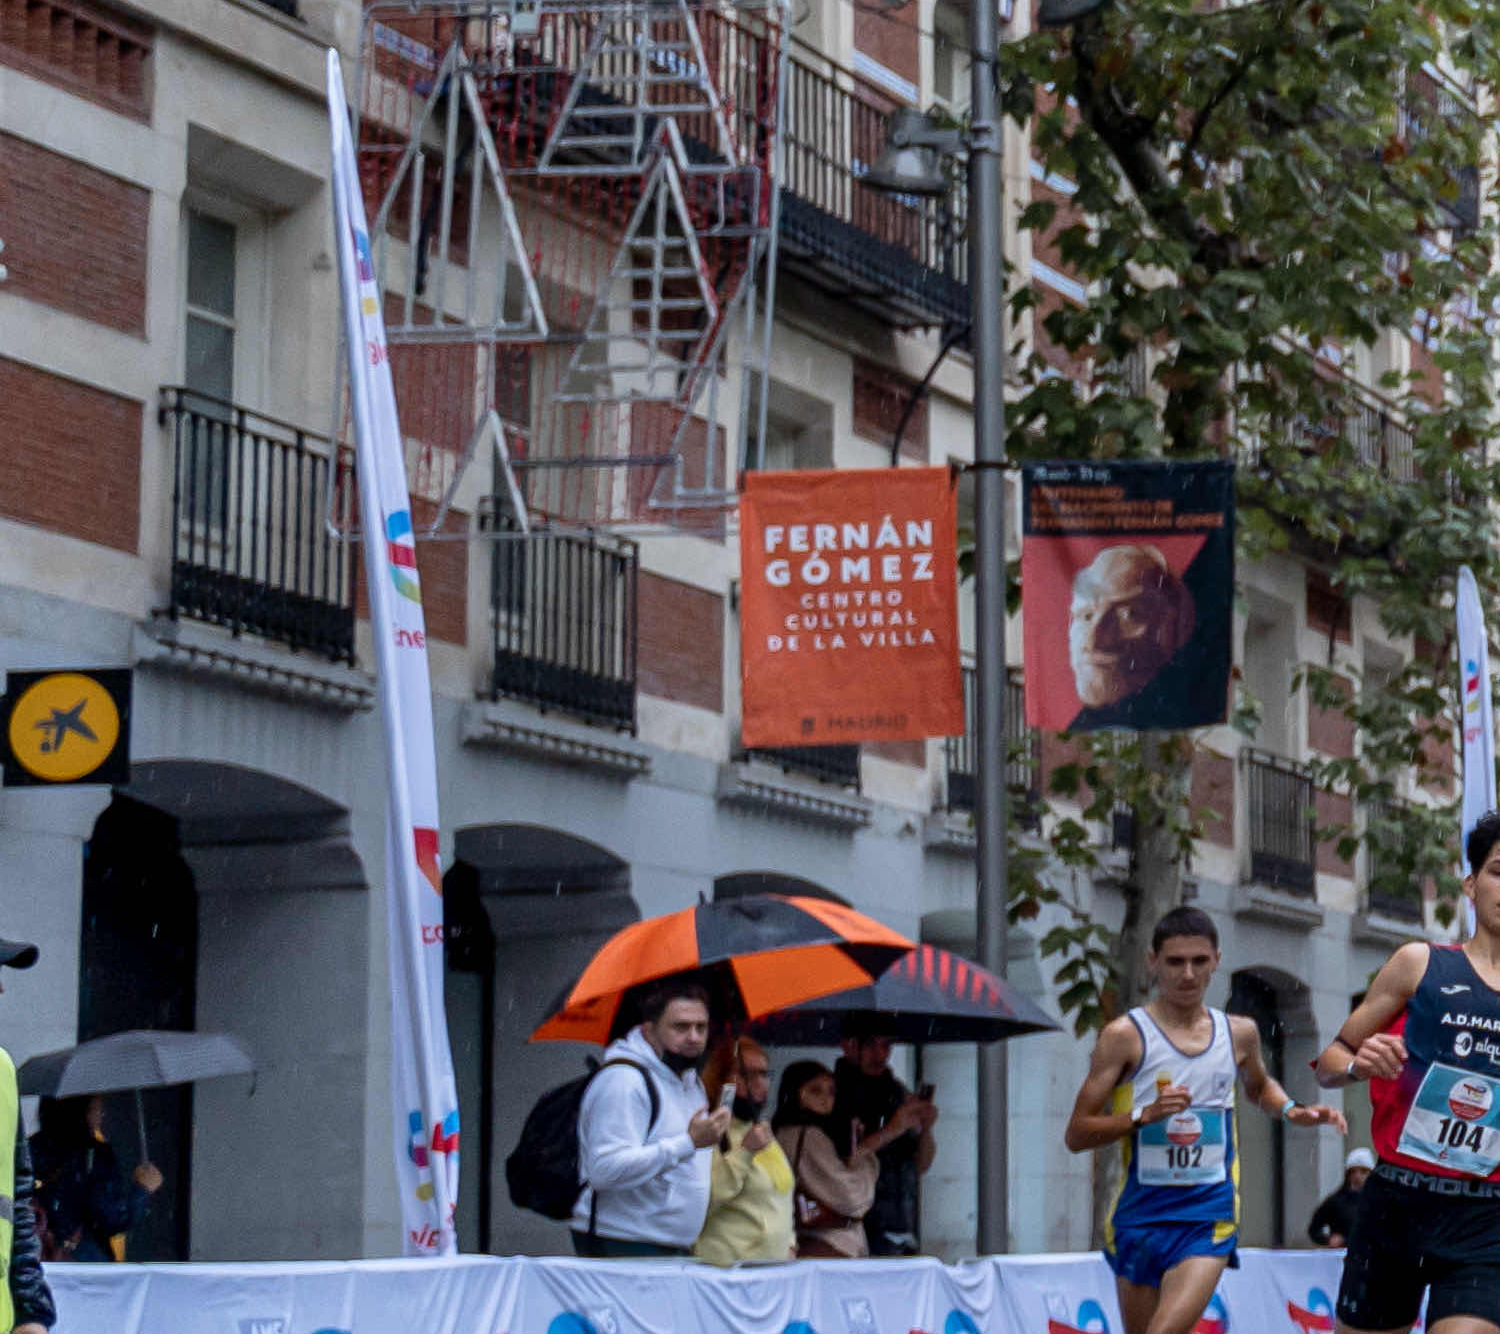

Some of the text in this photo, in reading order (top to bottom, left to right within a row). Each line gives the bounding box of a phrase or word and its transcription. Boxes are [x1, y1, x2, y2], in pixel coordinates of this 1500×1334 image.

[765, 515, 933, 553] FERNÁN
[765, 551, 934, 586] GÓMEZ
[801, 590, 903, 608] CENTRO
[785, 610, 917, 630] CULTURAL
[767, 629, 935, 651] DE LA VILLA
[1438, 1118, 1484, 1153] 104
[1166, 1146, 1203, 1169] 102
